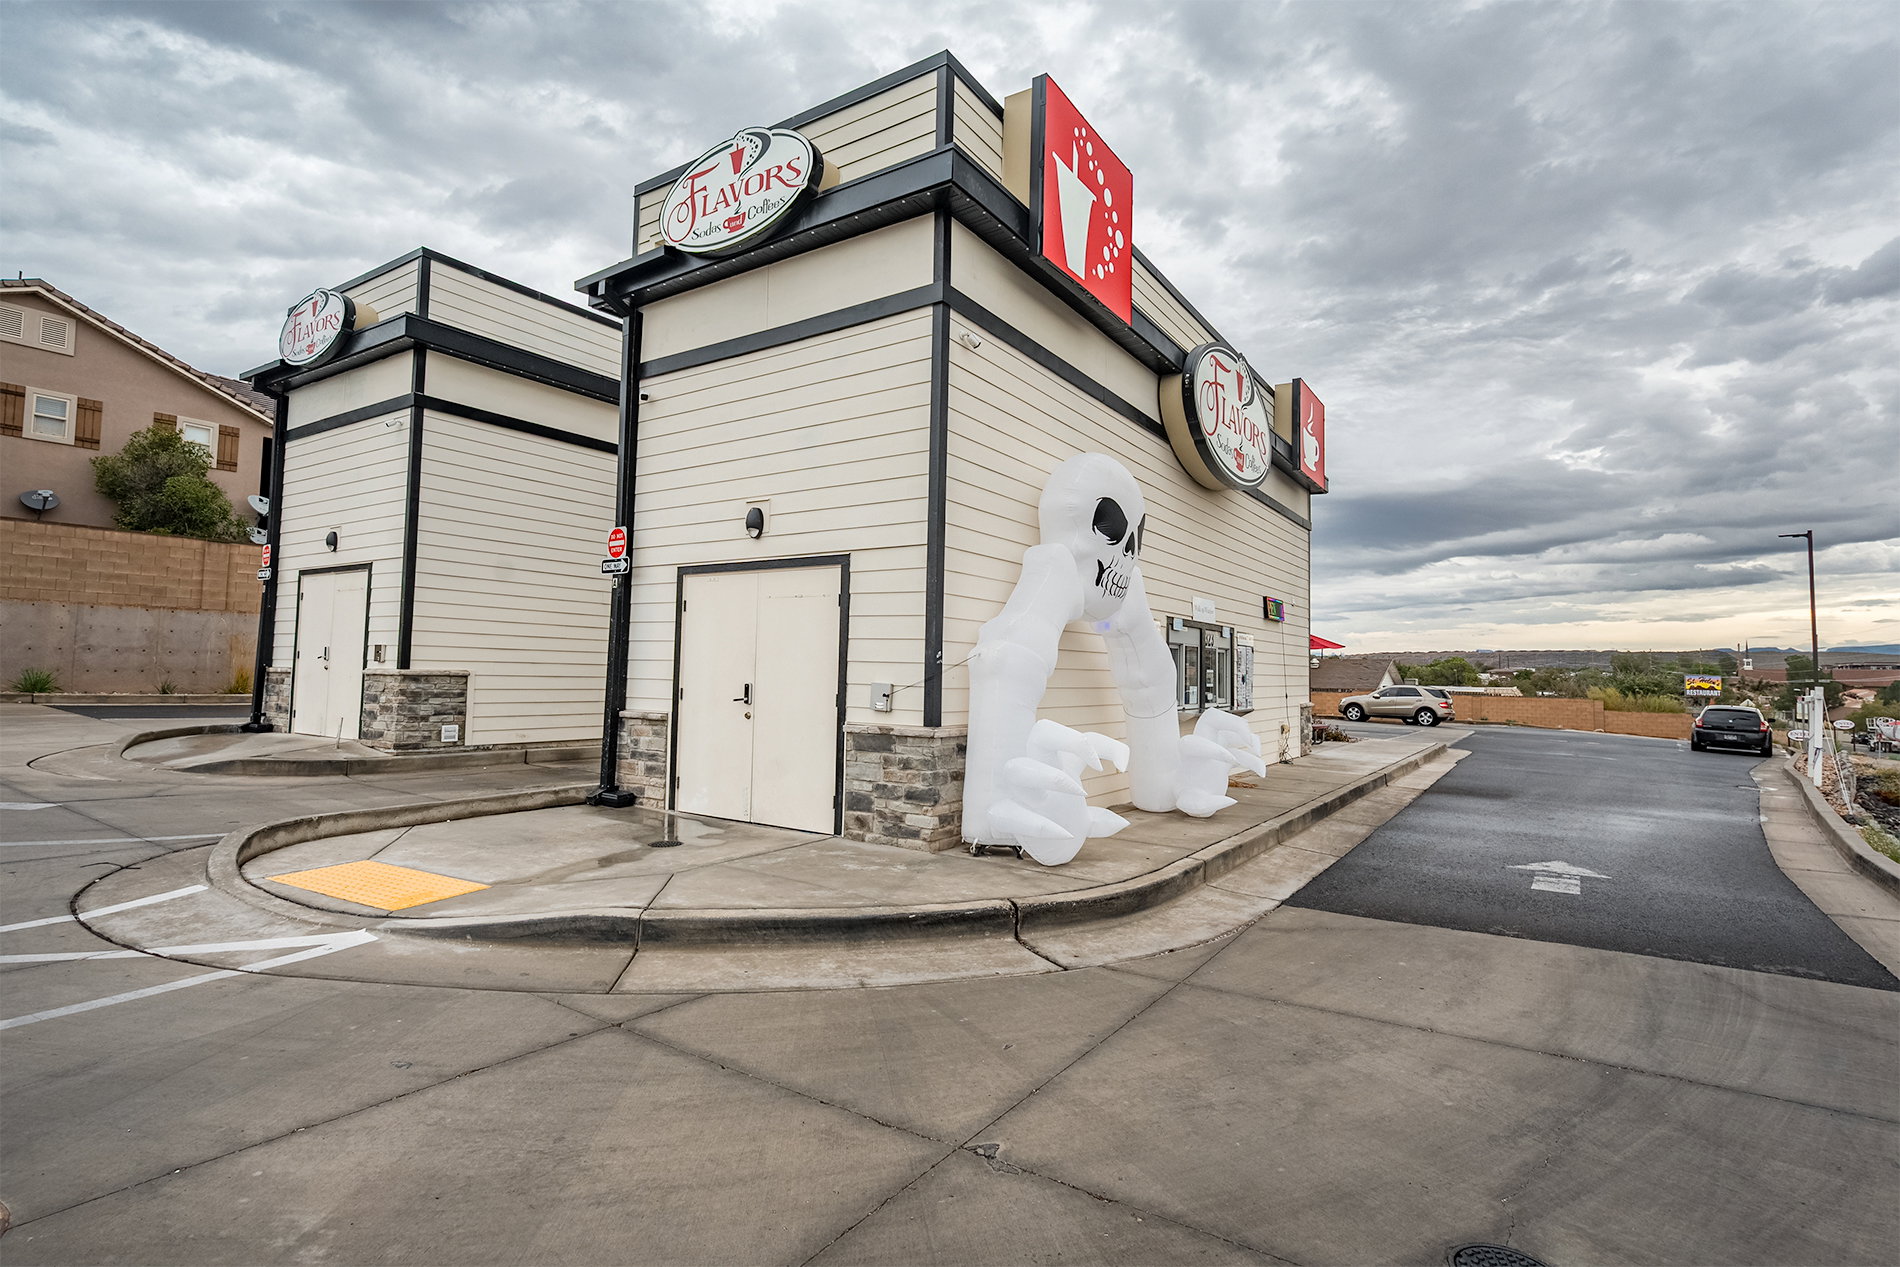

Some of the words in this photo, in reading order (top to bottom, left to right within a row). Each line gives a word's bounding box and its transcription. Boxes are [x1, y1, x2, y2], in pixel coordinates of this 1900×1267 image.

[691, 221, 722, 241] Sodas
[729, 214, 743, 228] and
[747, 195, 786, 220] Coffees
[1686, 689, 1721, 697] RESTAURANT
